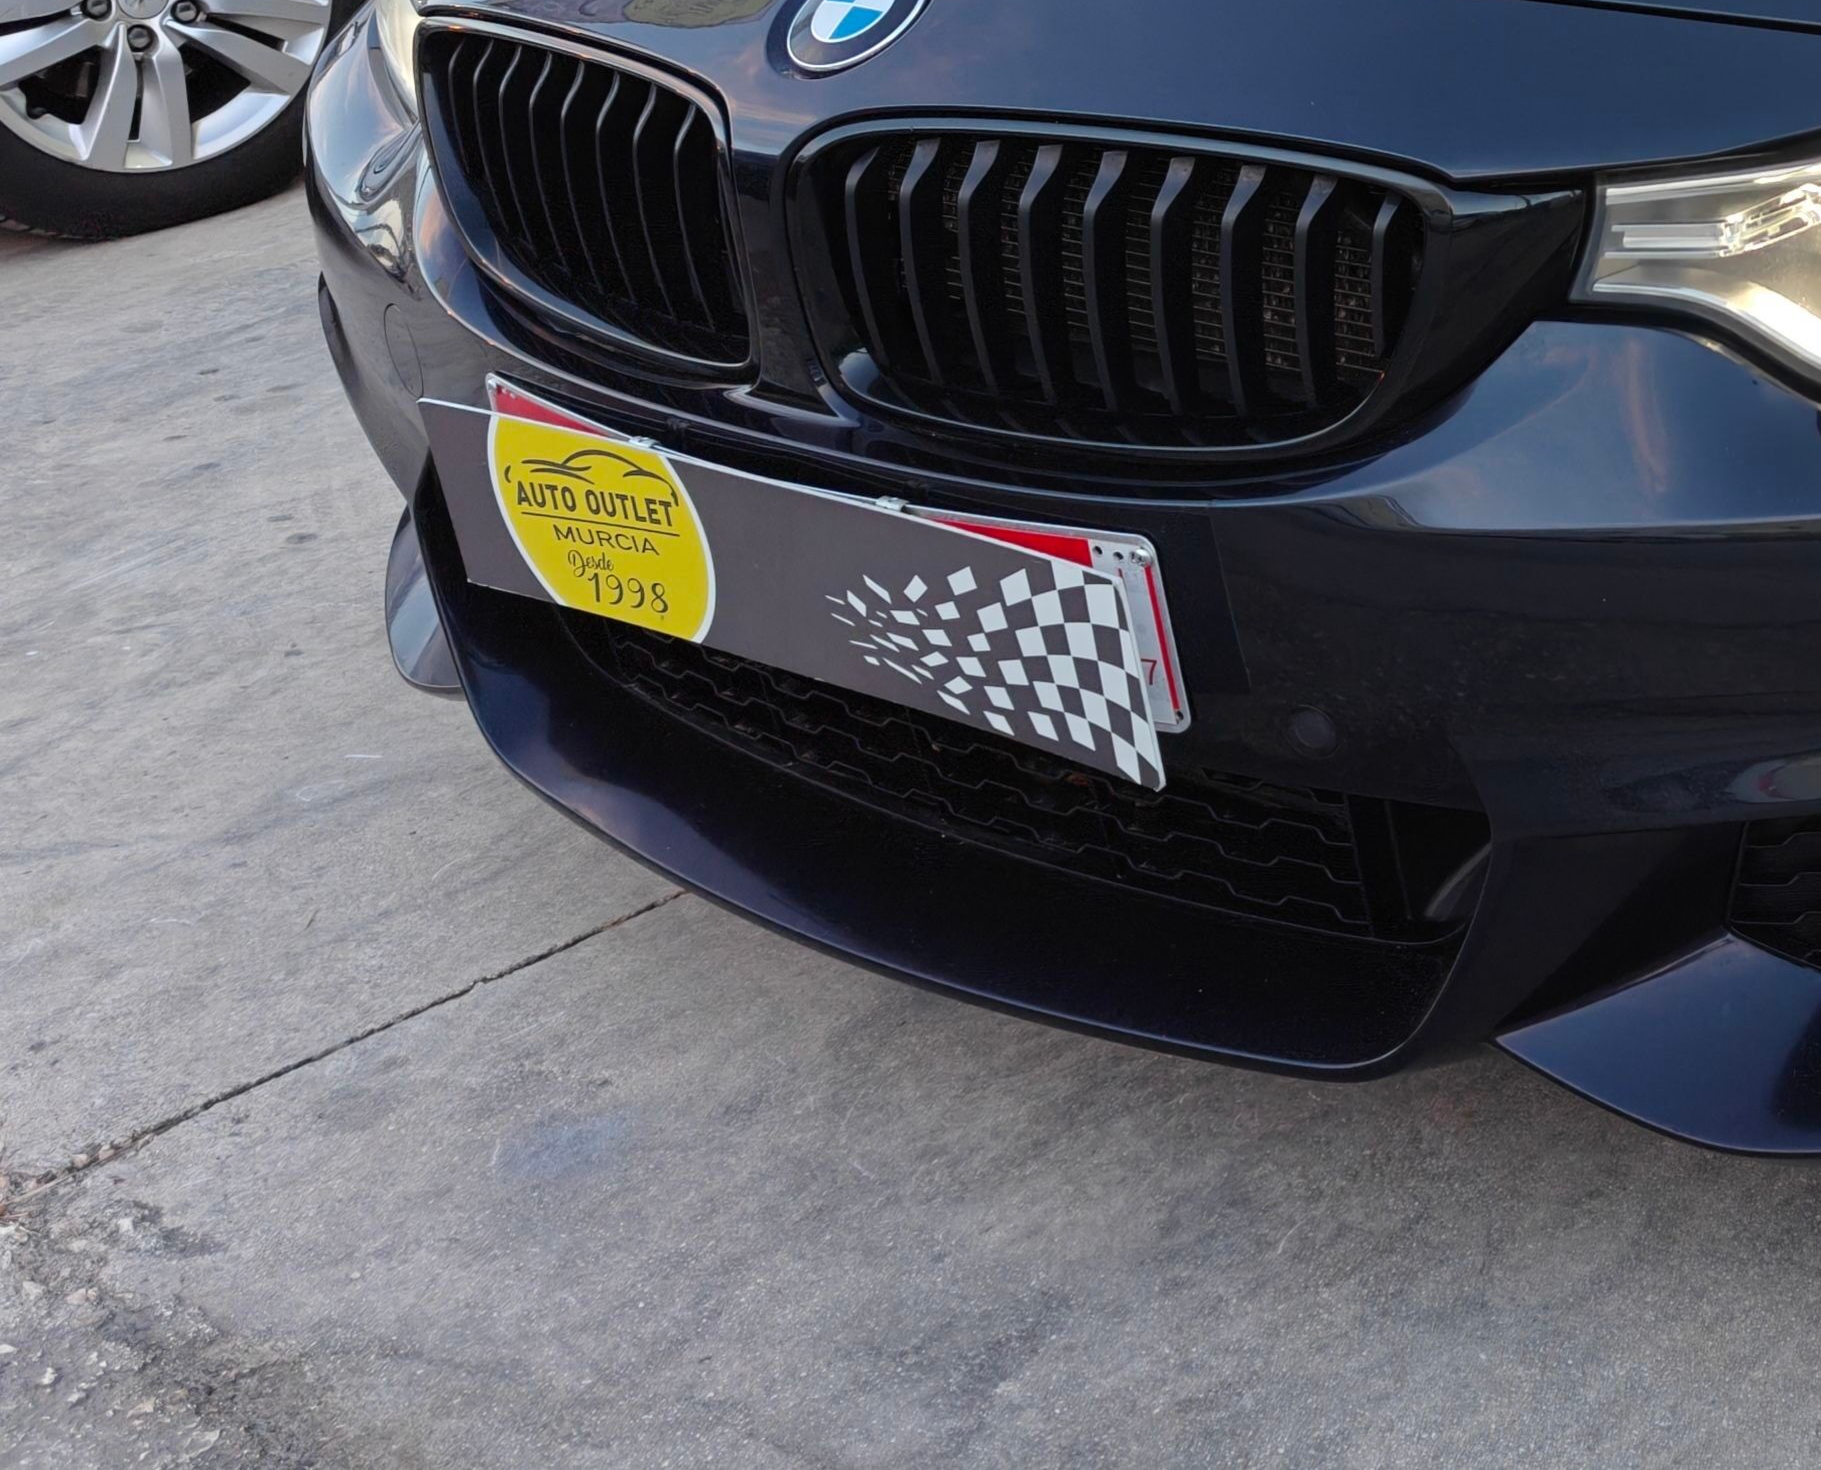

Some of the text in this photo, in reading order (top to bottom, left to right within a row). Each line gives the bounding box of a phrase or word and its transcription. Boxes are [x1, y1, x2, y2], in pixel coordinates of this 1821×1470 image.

[516, 480, 673, 527] AUTO OUTLET
[553, 524, 661, 556] MURCIA
[567, 549, 614, 578] Desde
[587, 572, 669, 614] 1998
